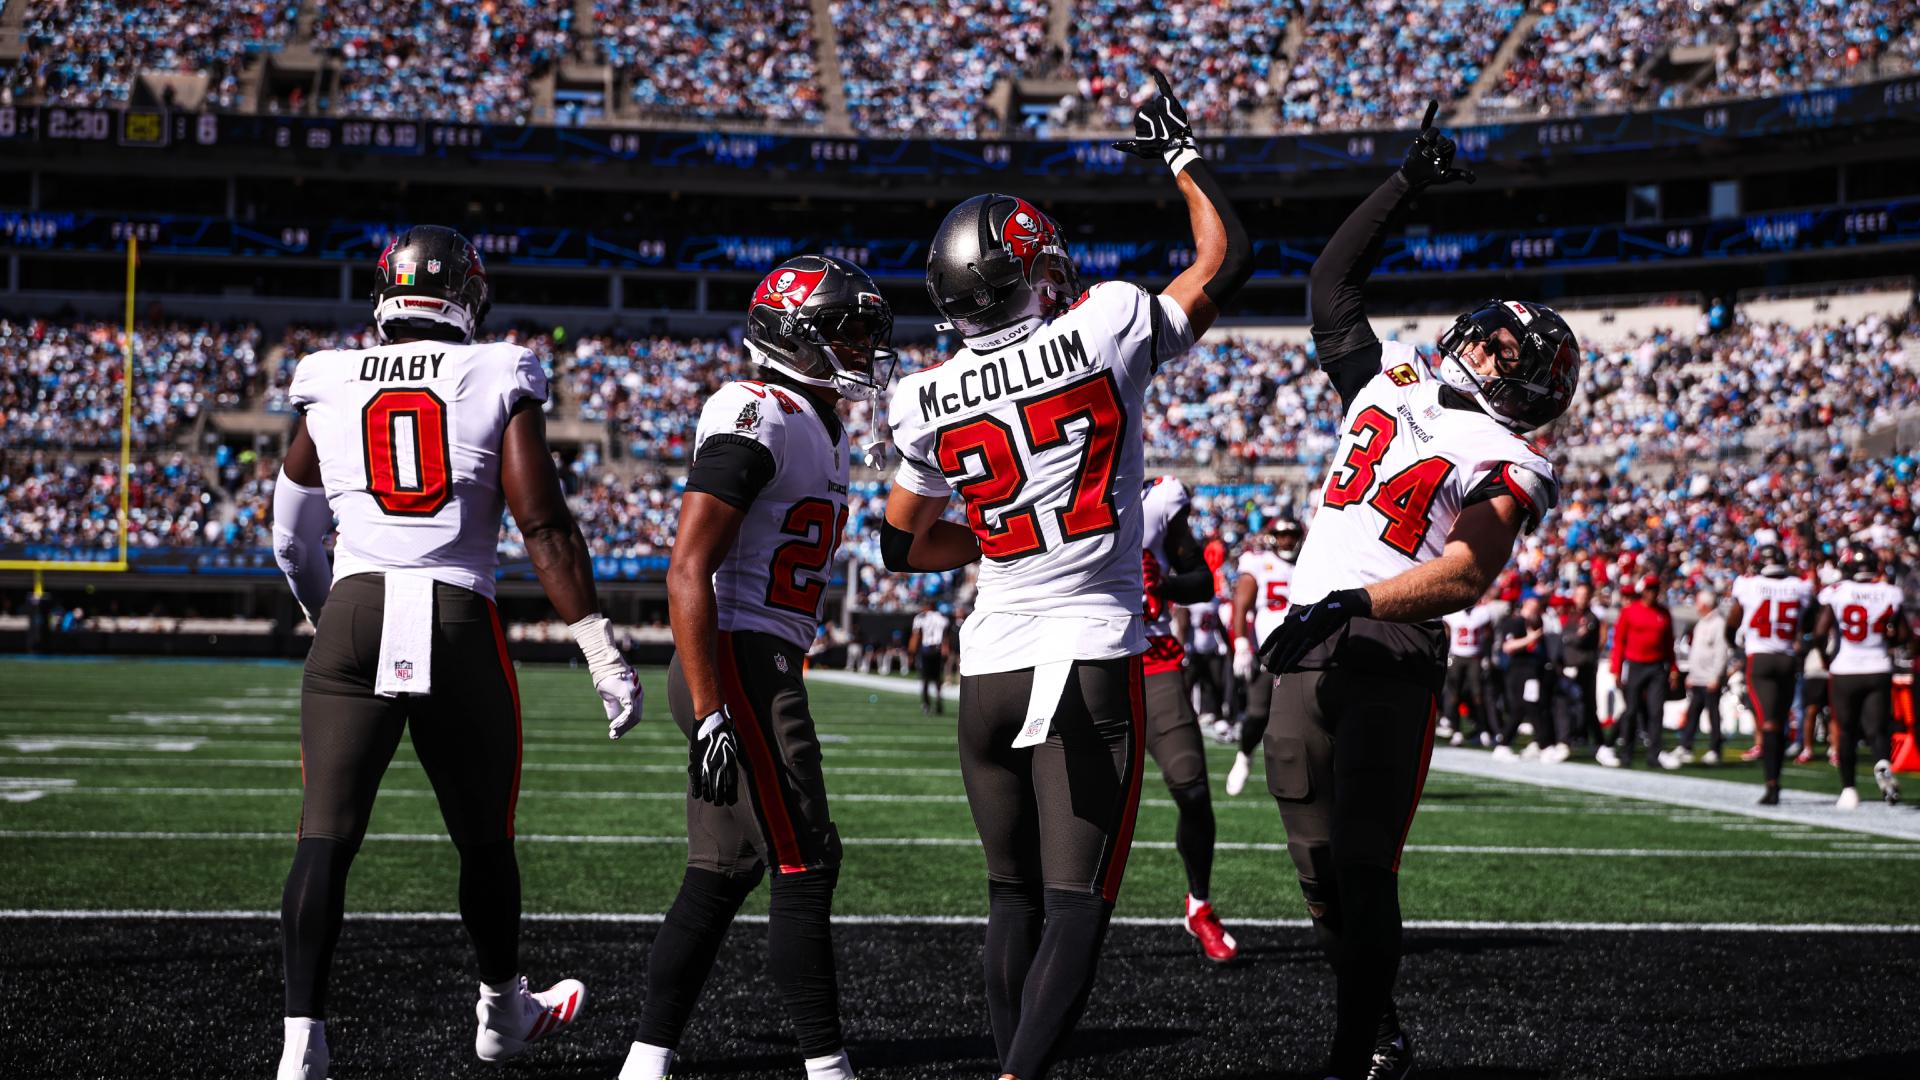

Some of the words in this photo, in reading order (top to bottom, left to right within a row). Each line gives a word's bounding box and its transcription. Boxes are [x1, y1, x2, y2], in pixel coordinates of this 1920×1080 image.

[48, 108, 110, 140] 2:30
[196, 112, 219, 145] 6
[342, 121, 373, 146] 1ST
[376, 121, 392, 147] &
[1537, 122, 1584, 145] FEET
[433, 125, 482, 147] FEET
[609, 133, 640, 154] ON
[1347, 136, 1375, 158] ON
[705, 137, 757, 159] YOUR
[810, 140, 859, 161] FEET
[982, 143, 1012, 164] ON
[5, 217, 58, 239] YOUR
[111, 221, 160, 242] FEET
[1751, 220, 1799, 243] YOUR
[1844, 210, 1889, 233] FEET
[280, 226, 310, 247] ON
[1510, 237, 1555, 258] FEET
[1665, 228, 1694, 250] ON
[638, 238, 667, 259] ON
[726, 243, 775, 264] YOUR
[1412, 242, 1463, 263] YOUR
[1002, 324, 1029, 342] LOVE
[360, 352, 446, 382] DIABY
[918, 329, 1090, 423] McCOLLUM
[1393, 363, 1418, 384] C
[361, 387, 453, 517] 0
[934, 367, 1128, 563] 27
[1323, 404, 1457, 561] 34
[1750, 598, 1801, 641] 45
[1842, 603, 1893, 643] 94
